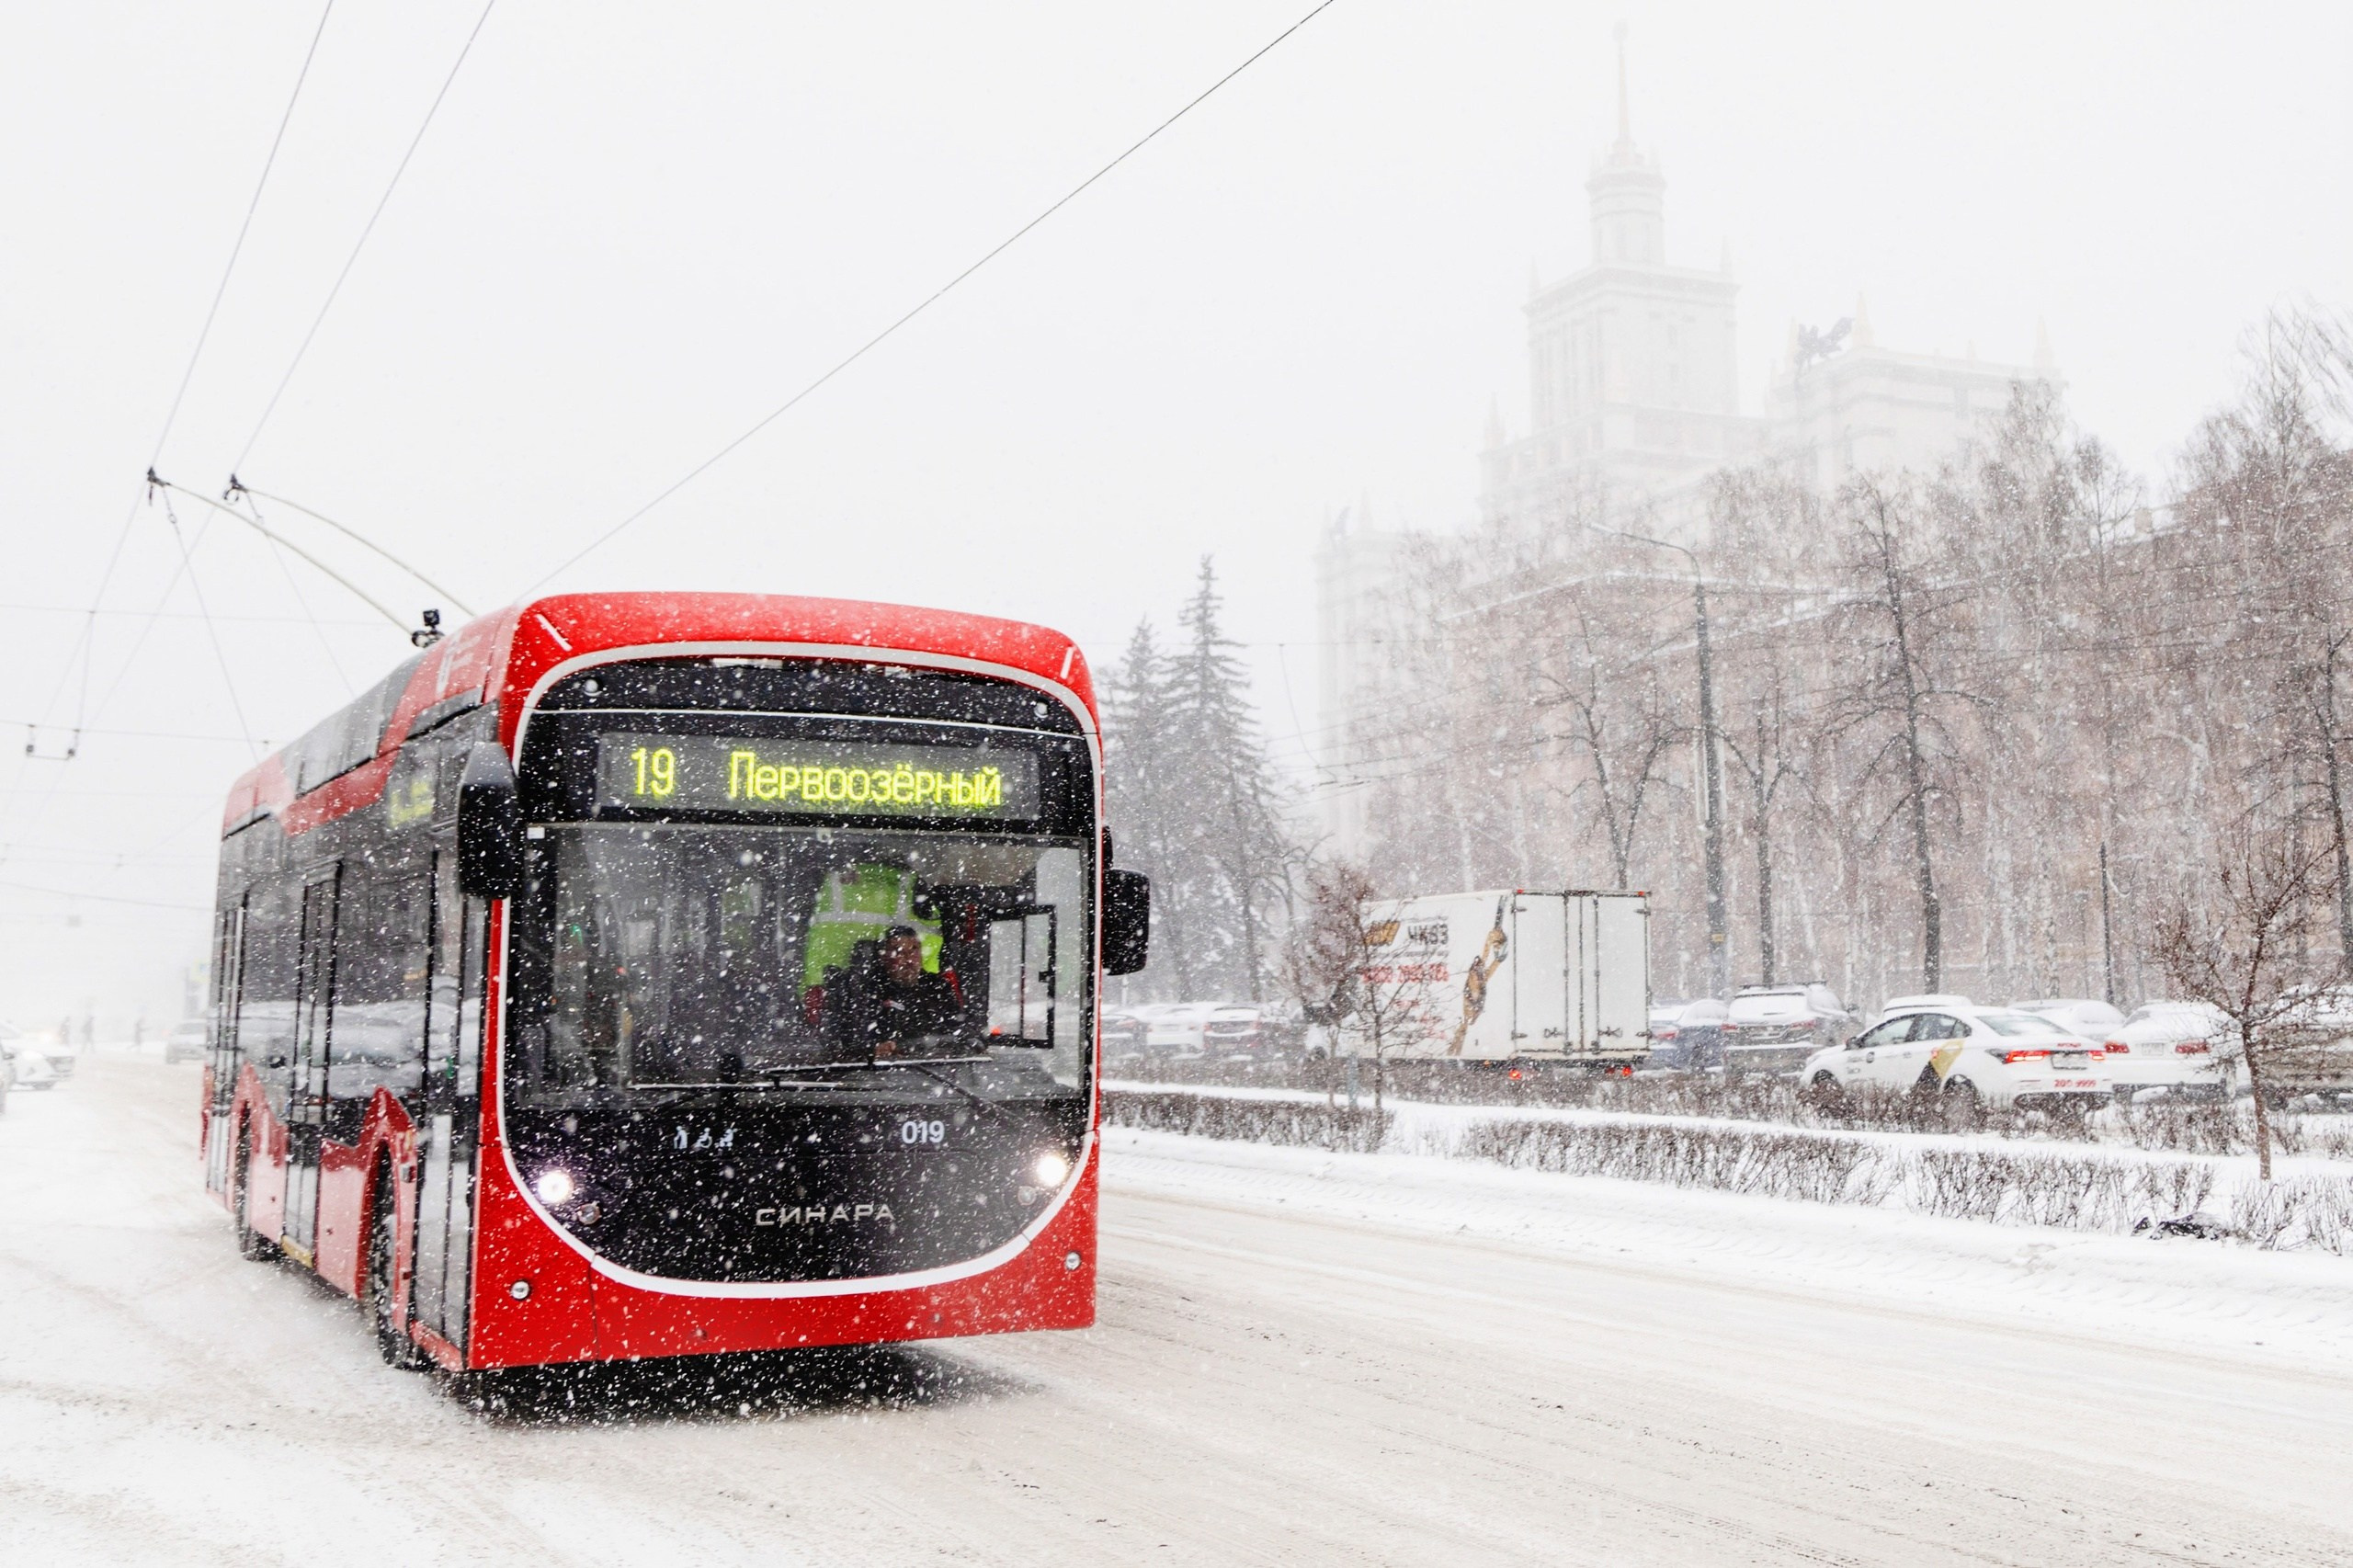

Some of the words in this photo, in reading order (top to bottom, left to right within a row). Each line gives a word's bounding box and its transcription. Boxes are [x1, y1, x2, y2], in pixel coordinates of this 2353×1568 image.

[631, 746, 676, 797] 19
[729, 749, 1002, 807] Первоозёрный
[902, 1120, 945, 1144] 019
[756, 1203, 895, 1227] СИНАРА
